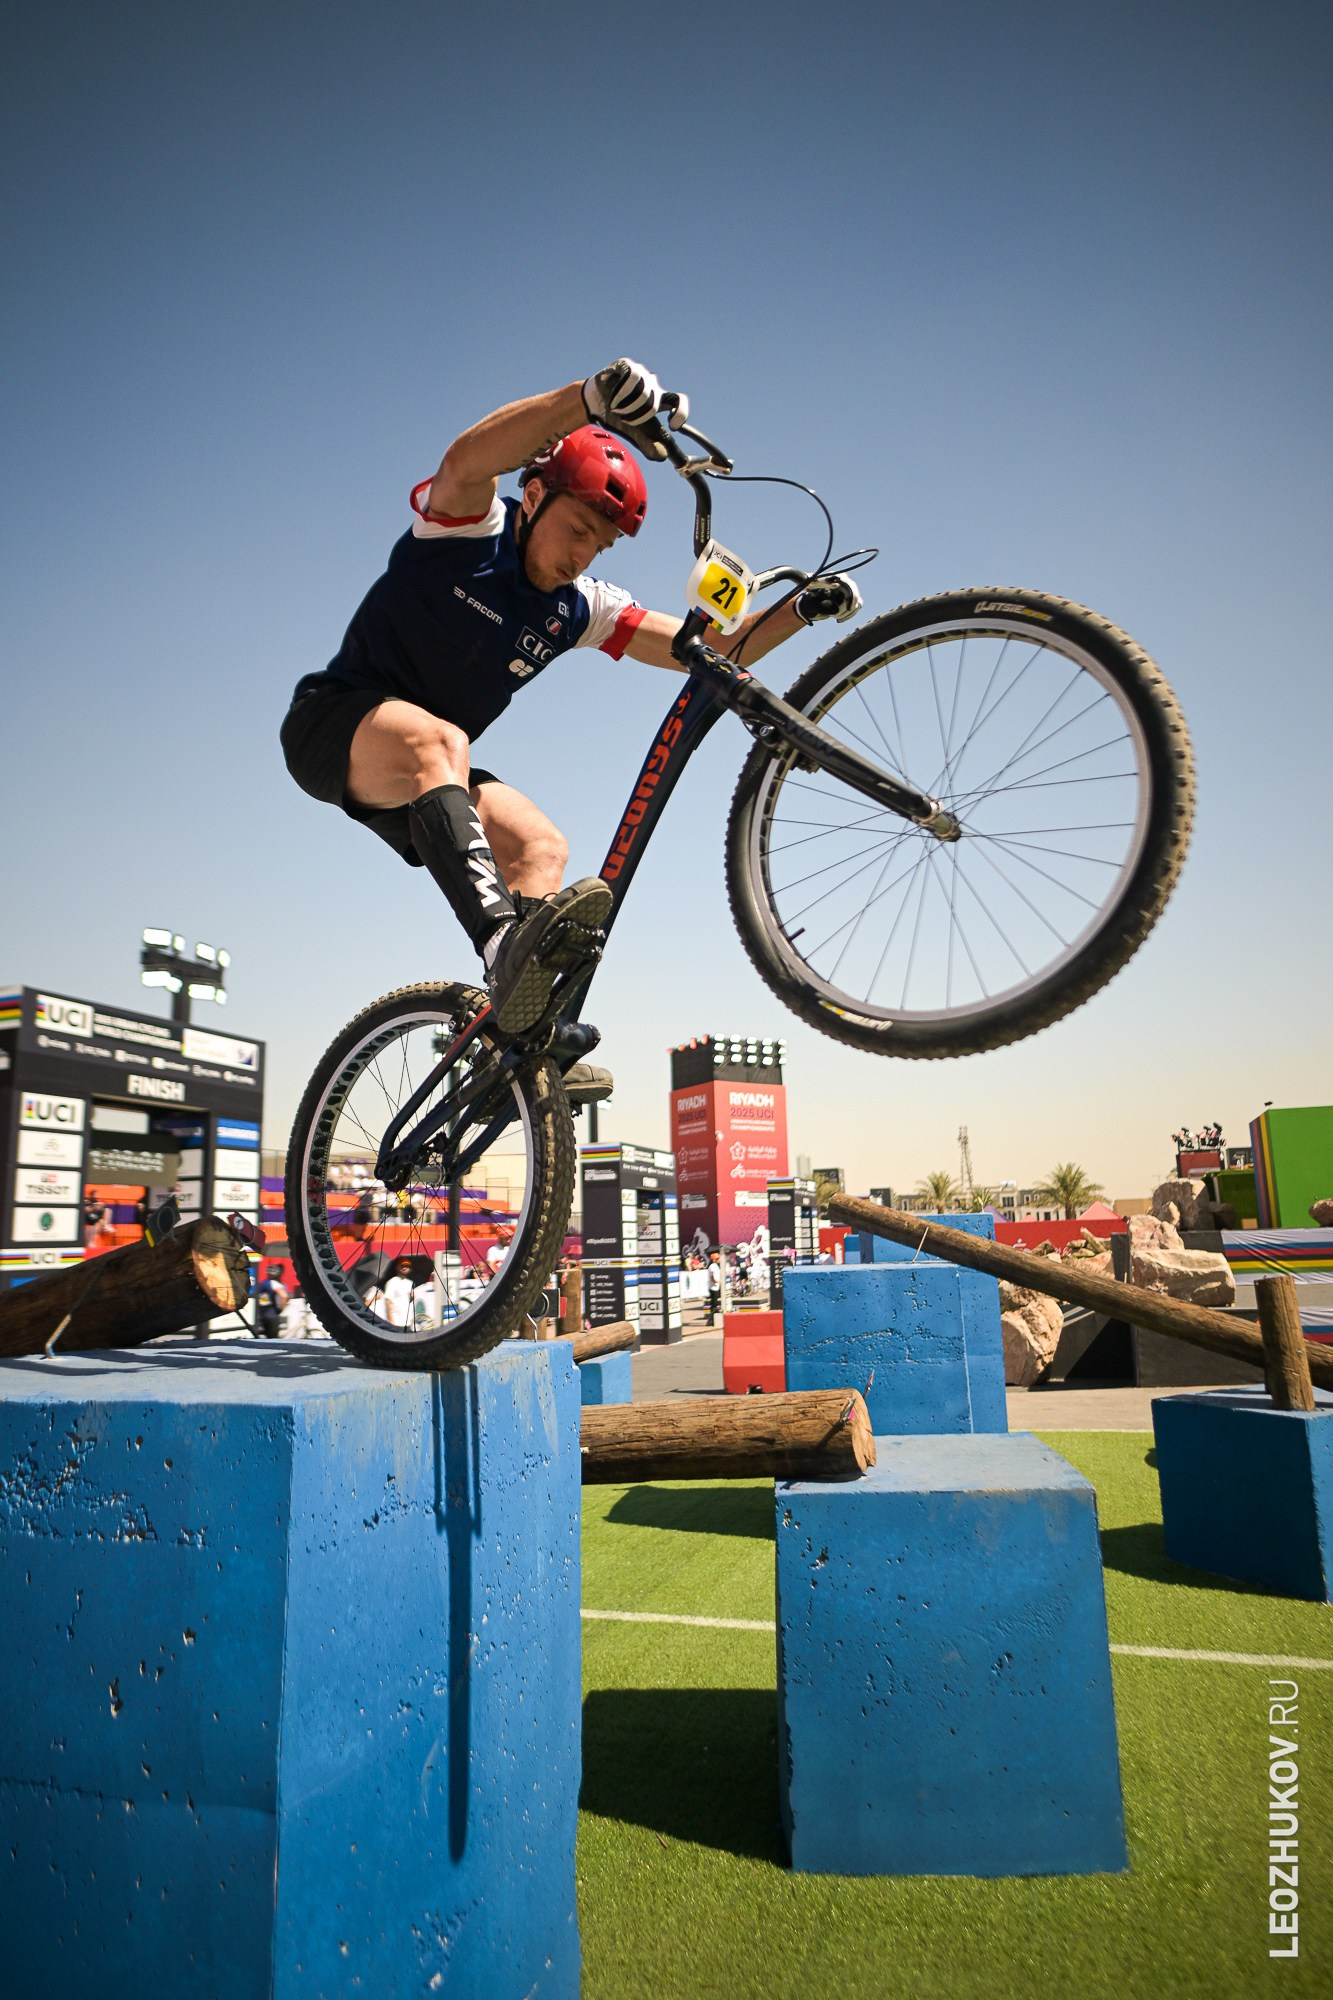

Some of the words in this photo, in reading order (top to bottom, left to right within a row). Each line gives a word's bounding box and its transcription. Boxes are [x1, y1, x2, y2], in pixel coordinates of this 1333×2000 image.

[711, 577, 738, 610] 21
[466, 596, 503, 626] FACOM
[522, 634, 553, 661] CIC
[46, 1004, 87, 1030] UCI
[127, 1074, 186, 1102] FINISH
[677, 1094, 706, 1111] RIYADH
[729, 1092, 774, 1107] RIYADH
[36, 1101, 76, 1123] UCI
[695, 1109, 707, 1120] UCI
[730, 1107, 754, 1118] 2025
[757, 1108, 774, 1119] UCI
[26, 1184, 70, 1196] TISSOT
[31, 1252, 57, 1265] UCI
[640, 1302, 659, 1311] UCI
